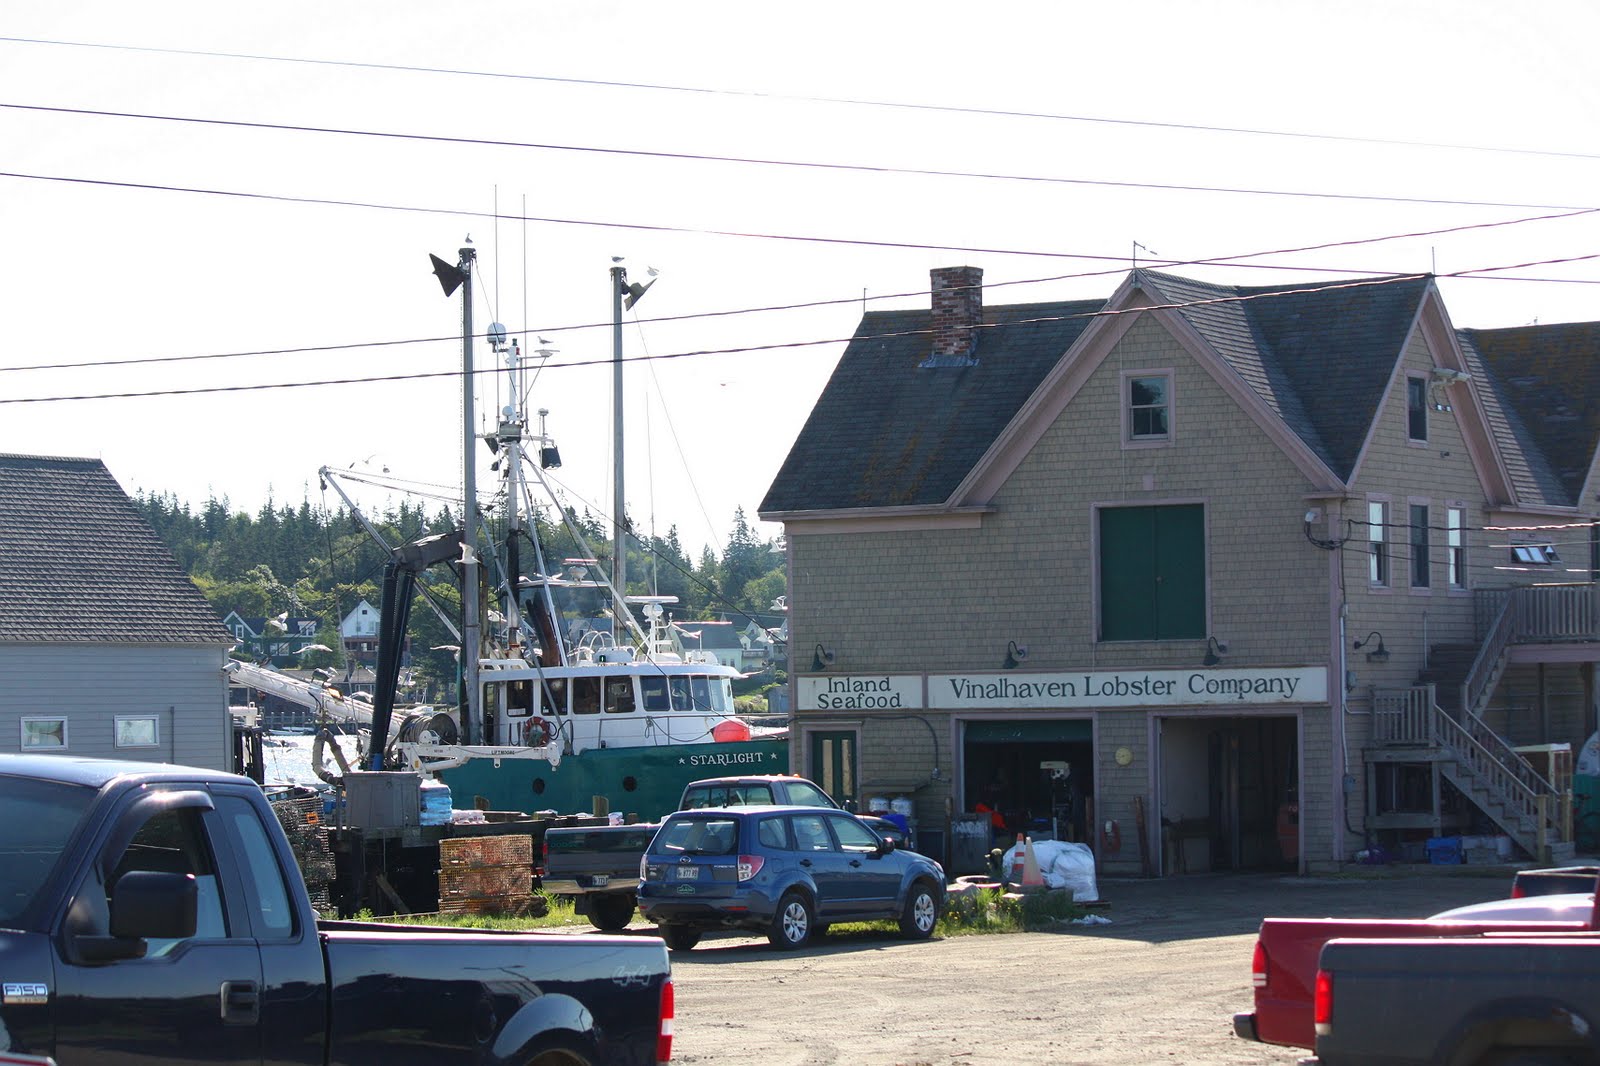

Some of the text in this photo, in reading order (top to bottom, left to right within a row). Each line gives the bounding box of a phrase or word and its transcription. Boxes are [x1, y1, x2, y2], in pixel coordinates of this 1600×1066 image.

[827, 676, 892, 693] Inland
[949, 673, 1301, 700] Vinalhaven Lobster Company
[817, 693, 902, 710] Seafood
[690, 752, 764, 766] STARLIGHT
